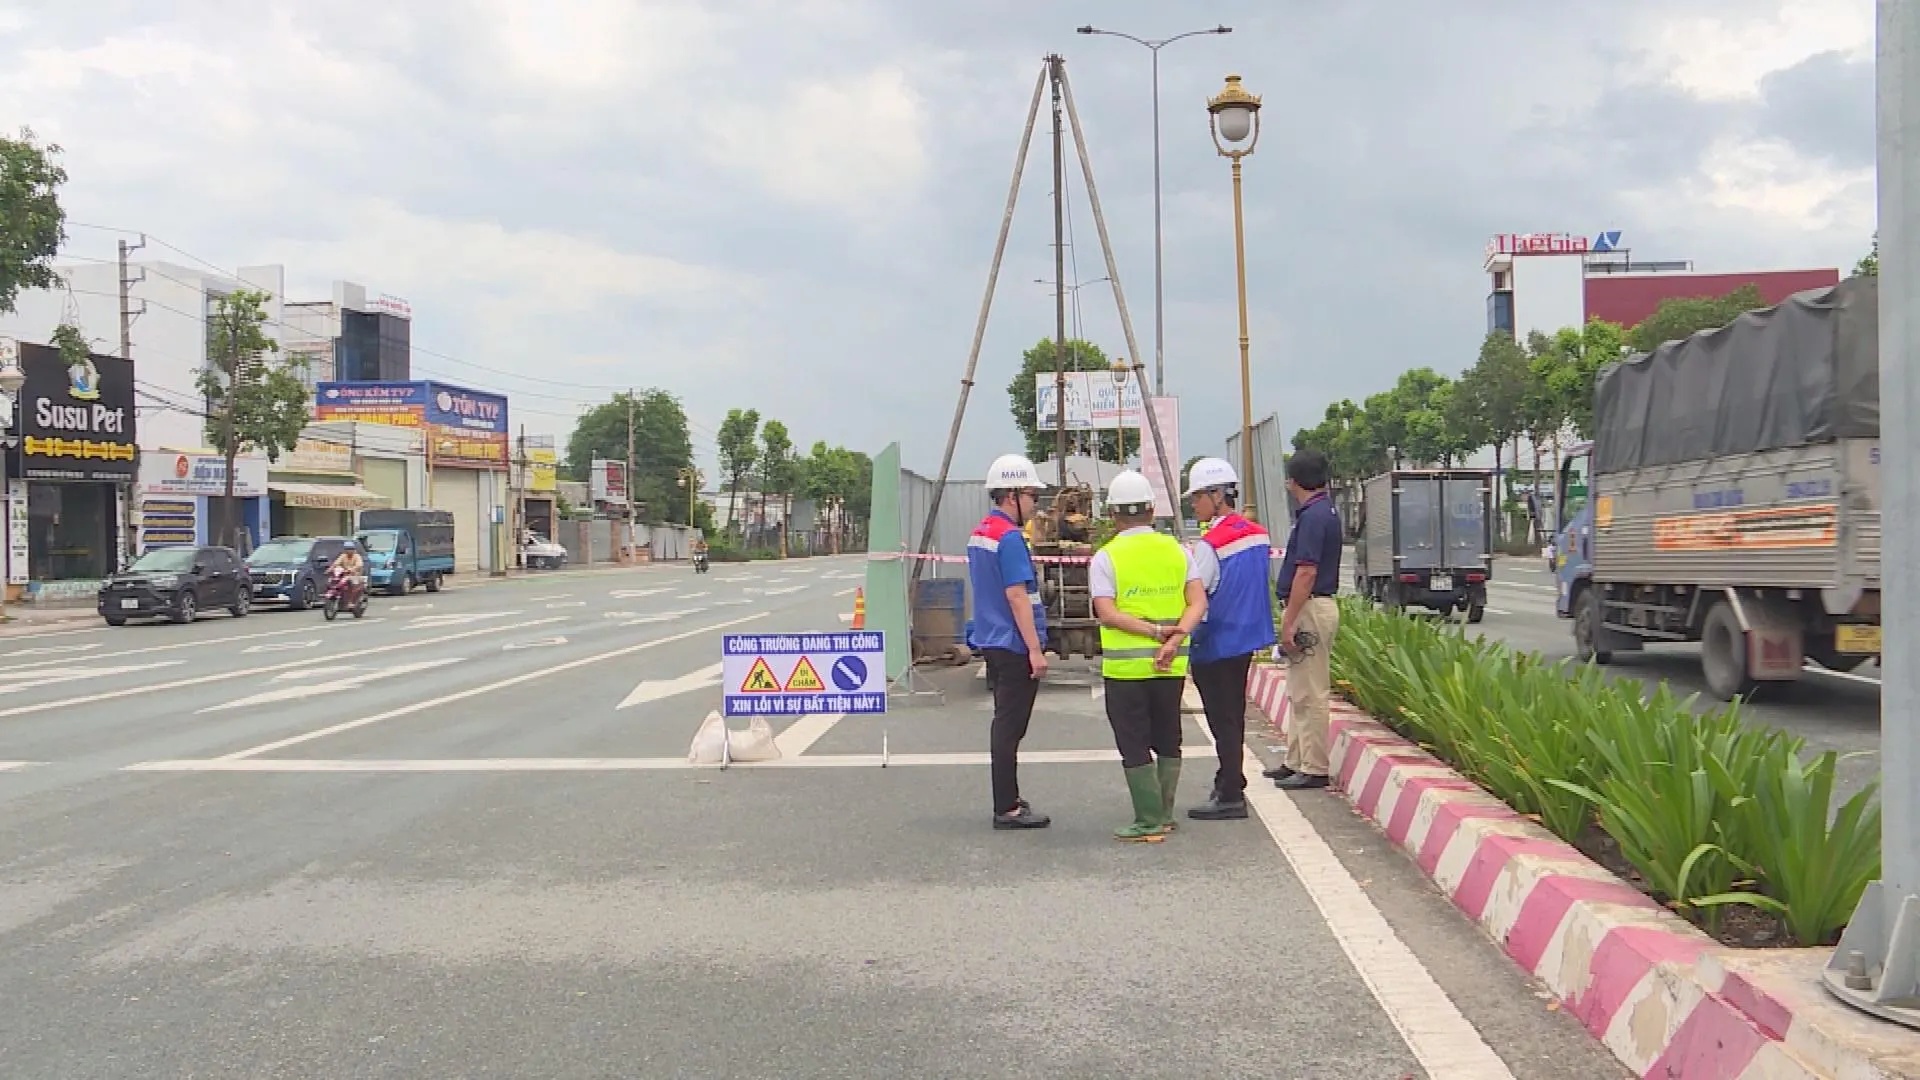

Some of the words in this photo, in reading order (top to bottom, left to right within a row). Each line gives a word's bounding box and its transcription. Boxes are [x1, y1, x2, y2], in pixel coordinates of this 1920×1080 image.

[36, 397, 87, 431] Susu
[92, 404, 123, 433] Pet
[729, 635, 757, 653] CÔNG
[760, 634, 800, 652] TRƯỜNG
[802, 636, 833, 651] ĐANG
[834, 635, 849, 650] THI
[851, 632, 879, 650] CÔNG
[732, 699, 751, 712] XIN
[754, 696, 771, 711] LỖI
[774, 695, 784, 711] VÌ
[786, 697, 801, 714] SỰ
[803, 694, 825, 712] BẤT
[827, 695, 851, 711] TIỆN
